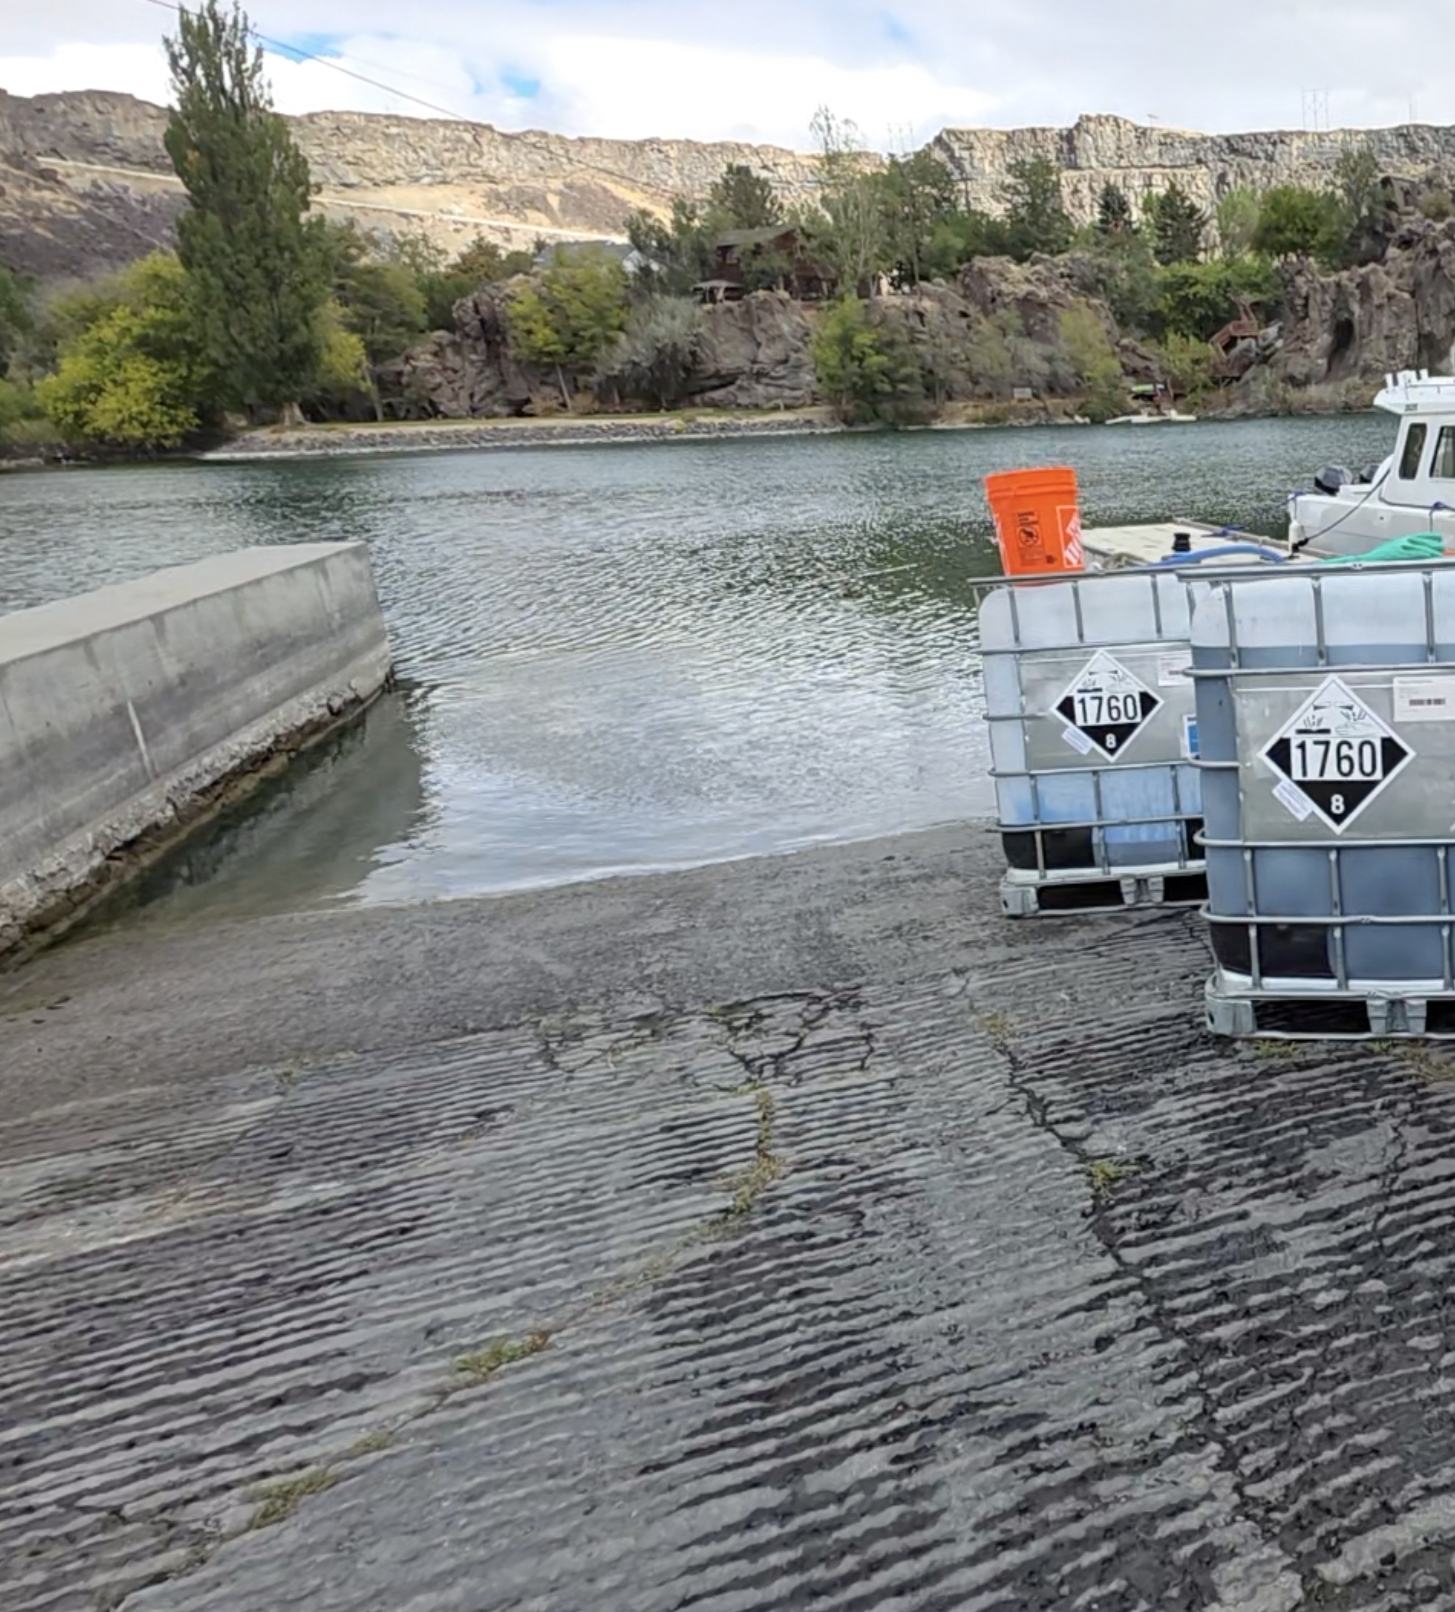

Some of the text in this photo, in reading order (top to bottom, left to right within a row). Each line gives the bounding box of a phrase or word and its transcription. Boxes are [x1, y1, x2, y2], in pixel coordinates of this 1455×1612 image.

[1078, 694, 1138, 723] 1760
[1105, 733, 1117, 748] 8
[1295, 739, 1378, 778] 1760
[1330, 794, 1345, 815] 8
